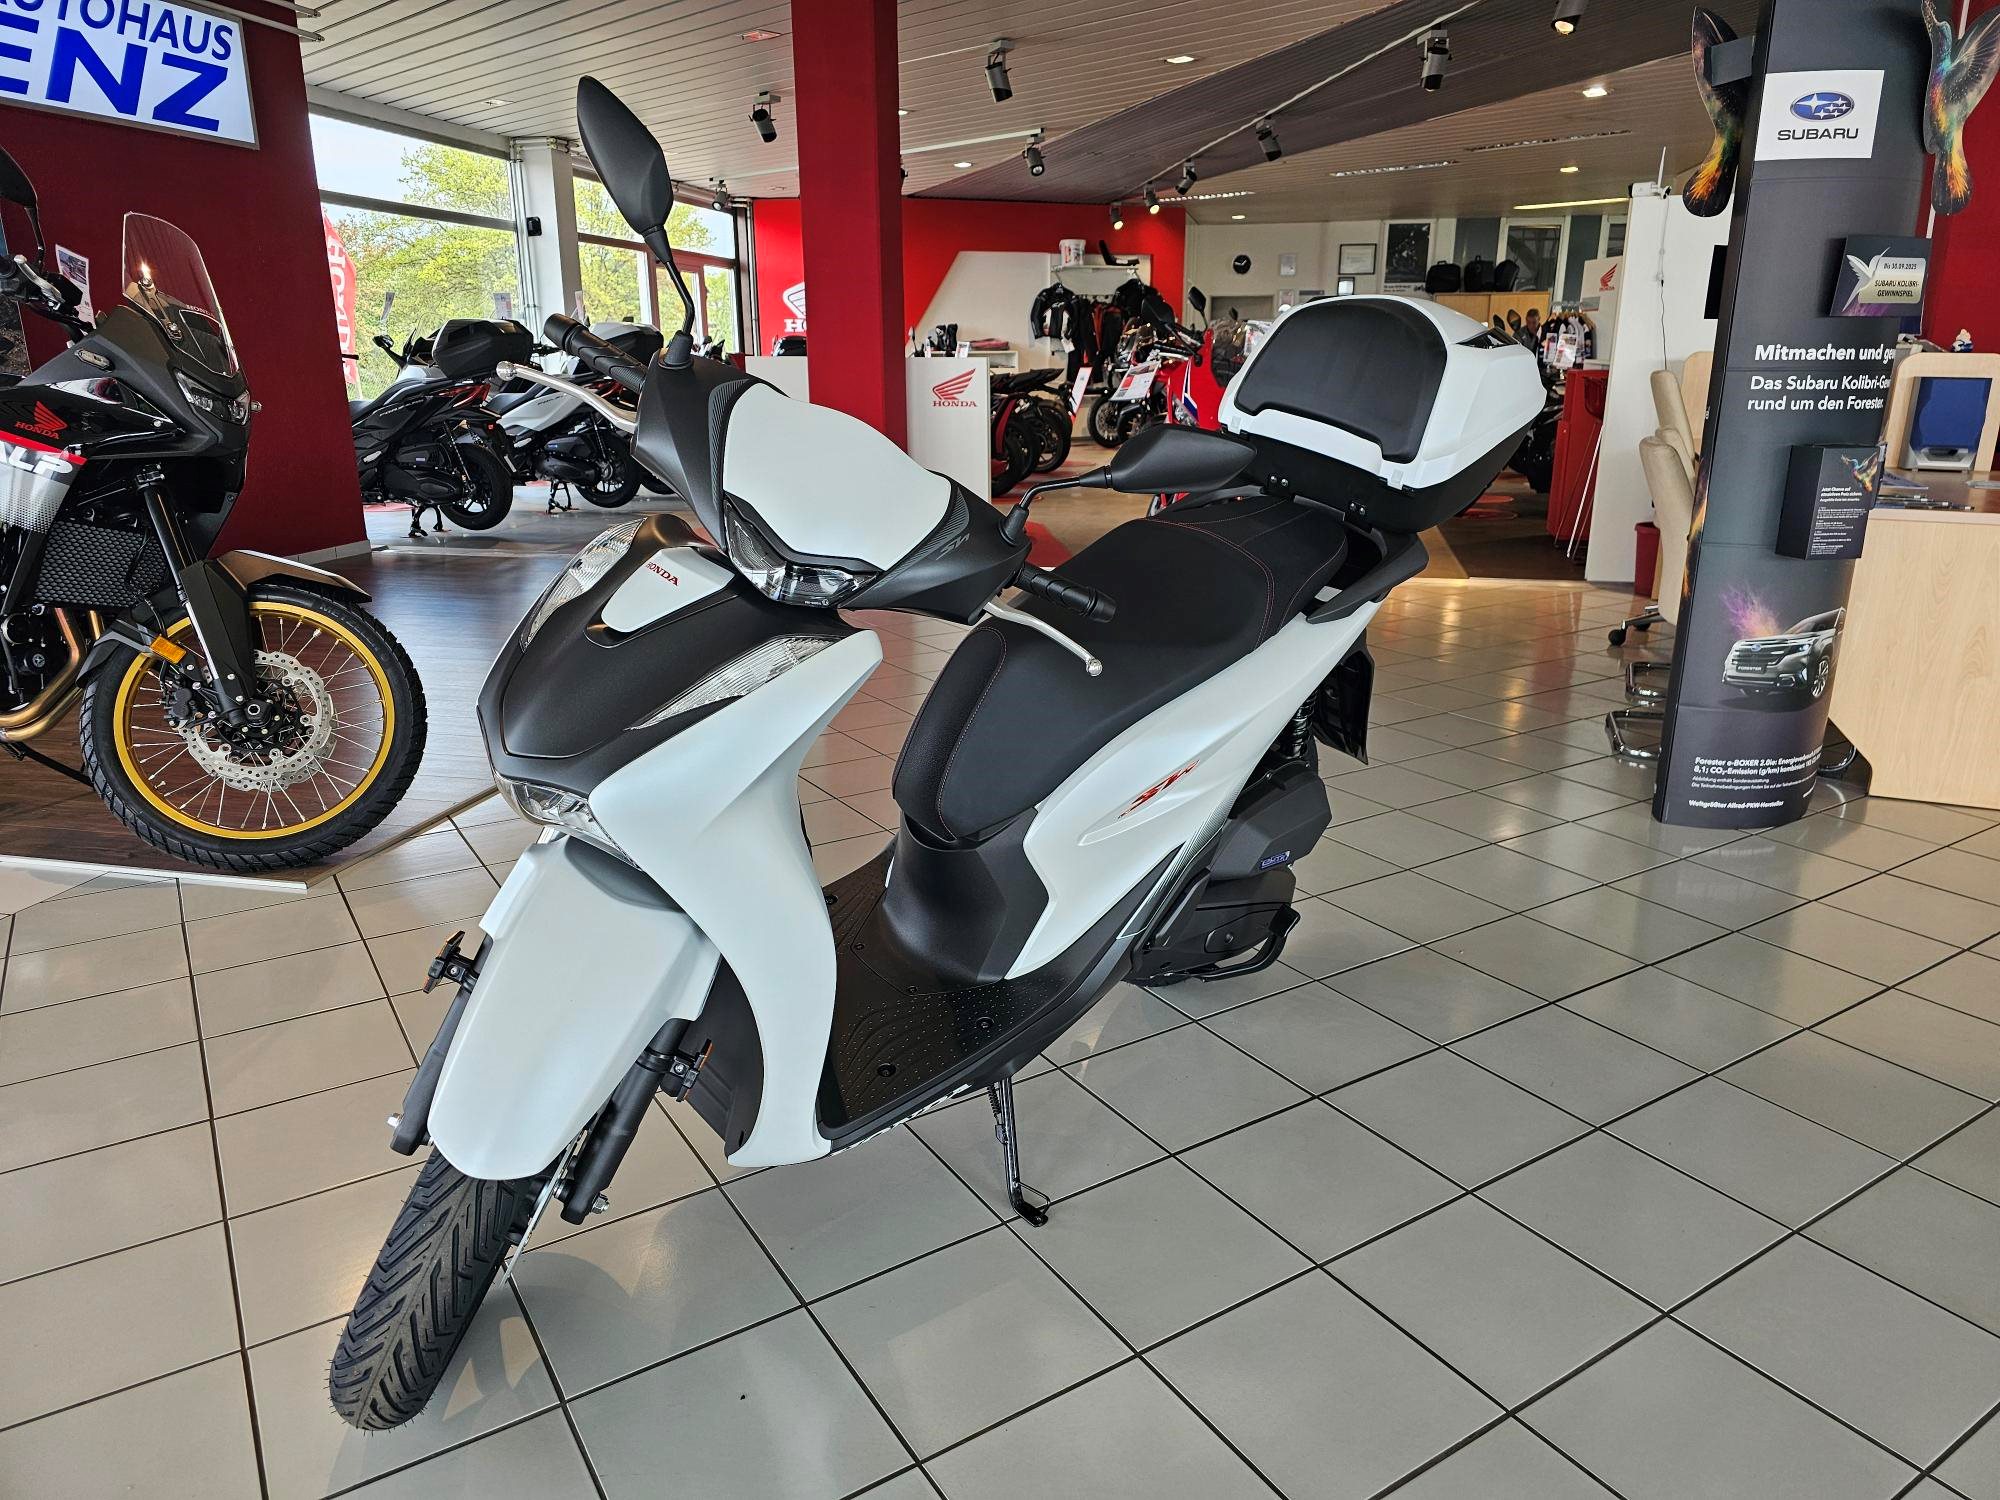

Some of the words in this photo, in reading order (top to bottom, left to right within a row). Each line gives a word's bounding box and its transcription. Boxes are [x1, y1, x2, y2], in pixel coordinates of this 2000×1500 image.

[0, 0, 233, 61] OHAUS
[1777, 128, 1859, 140] SUBARU
[1755, 344, 1855, 360] Mitmachen
[1859, 344, 1883, 360] und
[1751, 375, 1782, 390] Das
[1786, 375, 1838, 390] Subaru
[933, 400, 977, 408] HONDA
[1748, 395, 1786, 410] rund
[1791, 399, 1813, 410] um
[1818, 395, 1843, 410] den
[15, 421, 60, 440] HONDA
[645, 562, 678, 586] HONDA
[1695, 757, 1725, 766] Forester
[1759, 767, 1779, 776] (g/km)
